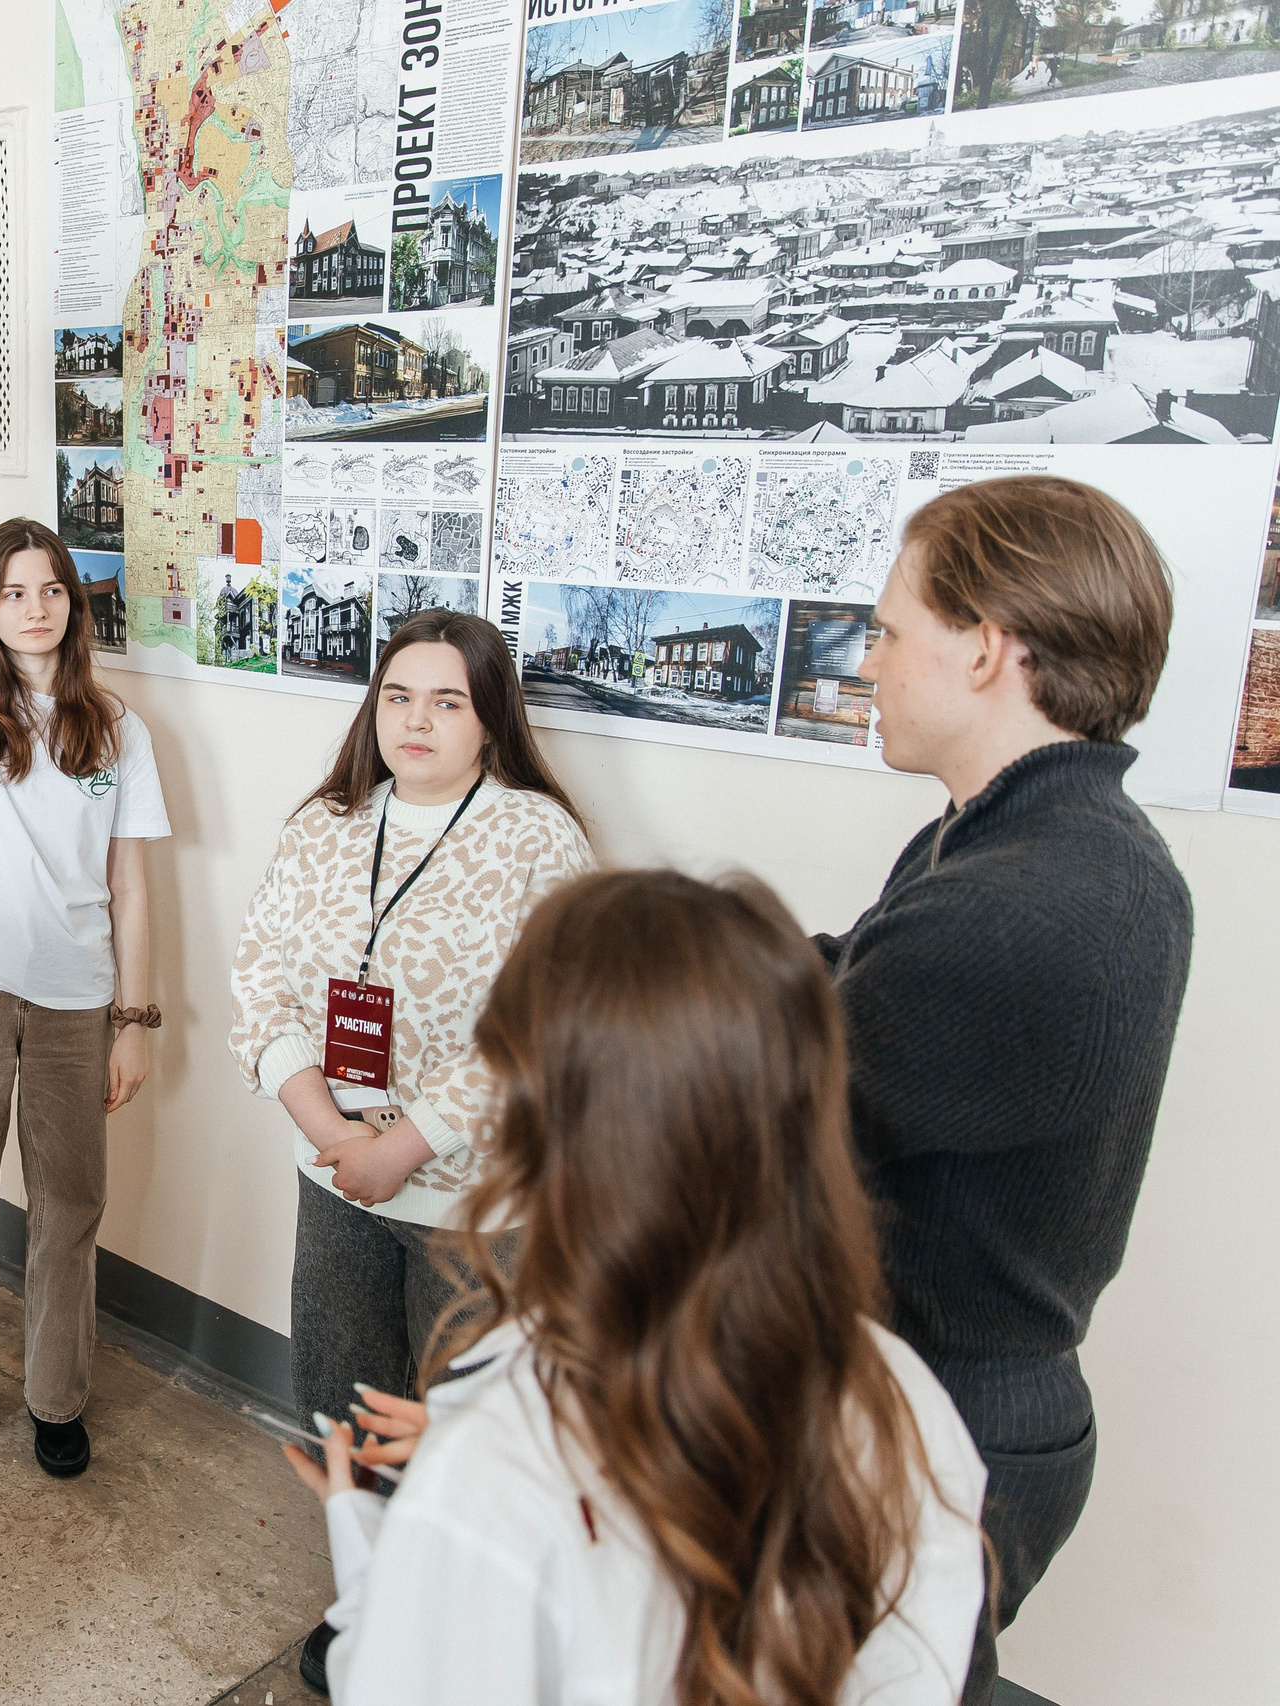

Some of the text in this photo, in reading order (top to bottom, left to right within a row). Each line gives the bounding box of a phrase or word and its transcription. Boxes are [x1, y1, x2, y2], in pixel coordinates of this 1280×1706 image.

[392, 84, 437, 233] ПРОЕКТ
[501, 580, 523, 626] МЖК
[334, 1014, 383, 1036] УЧАСТНИК
